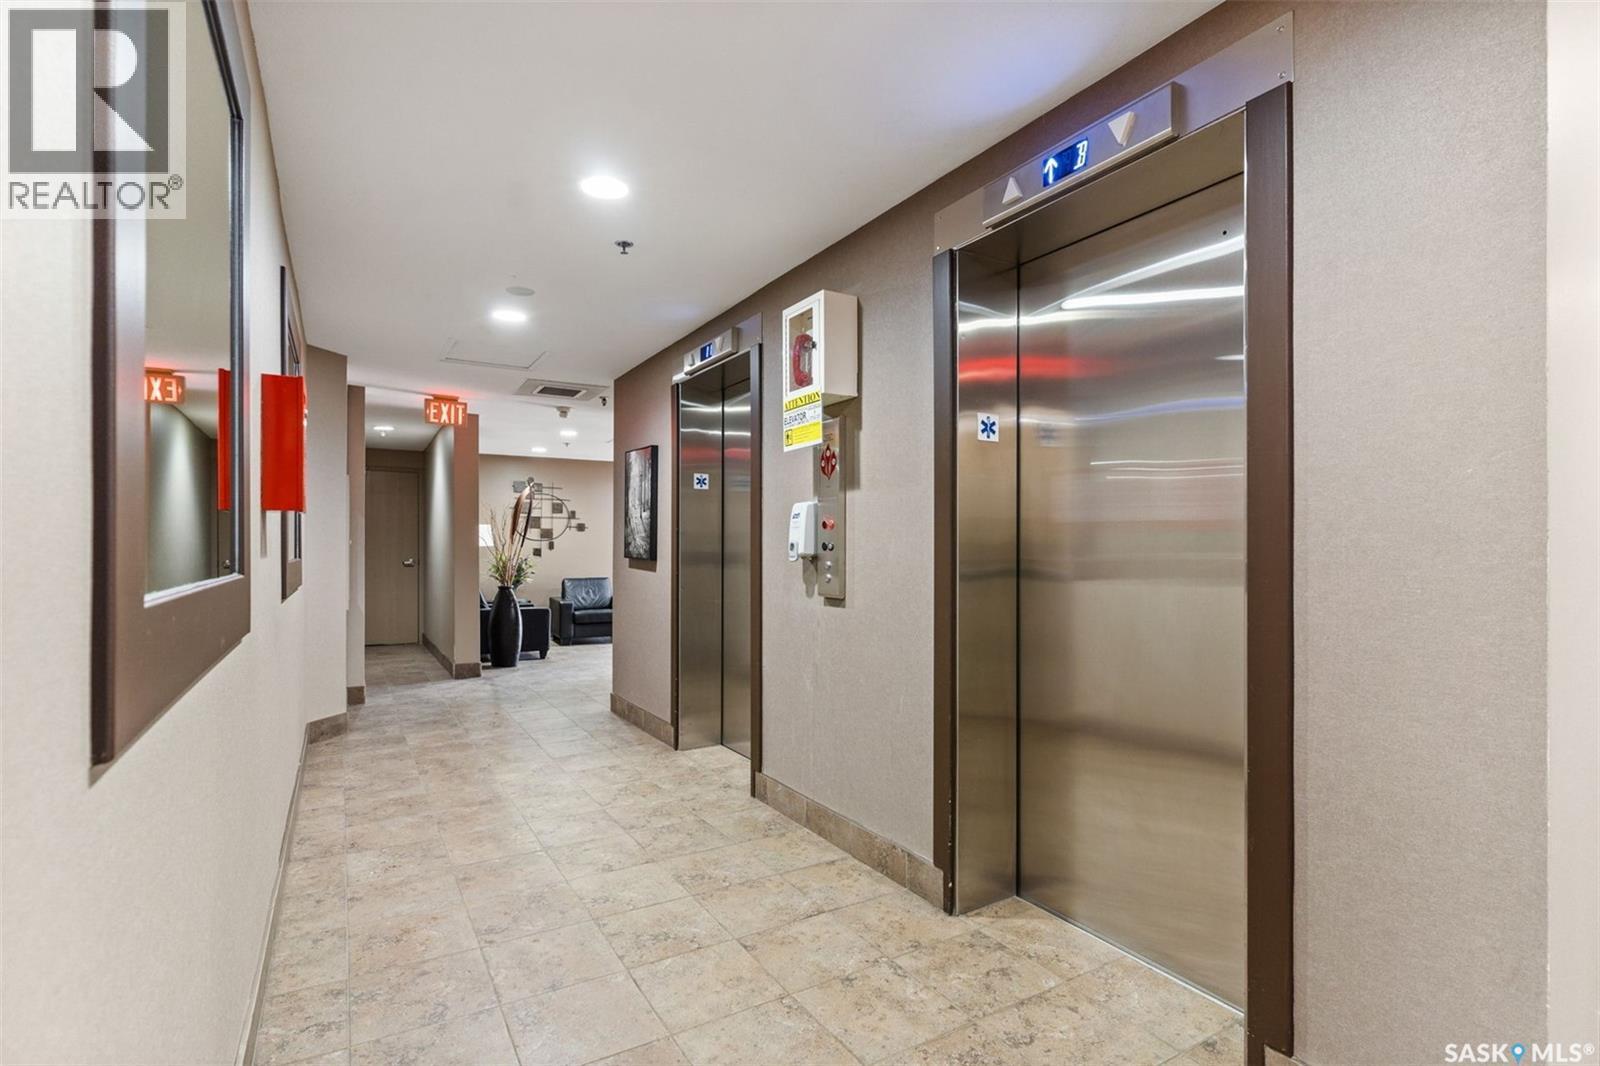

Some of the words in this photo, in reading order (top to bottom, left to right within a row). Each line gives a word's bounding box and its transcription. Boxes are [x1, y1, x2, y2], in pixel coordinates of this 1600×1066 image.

[784, 391, 821, 411] ATTENTION
[429, 401, 465, 425] EXIT
[784, 411, 808, 426] ELEVATOR
